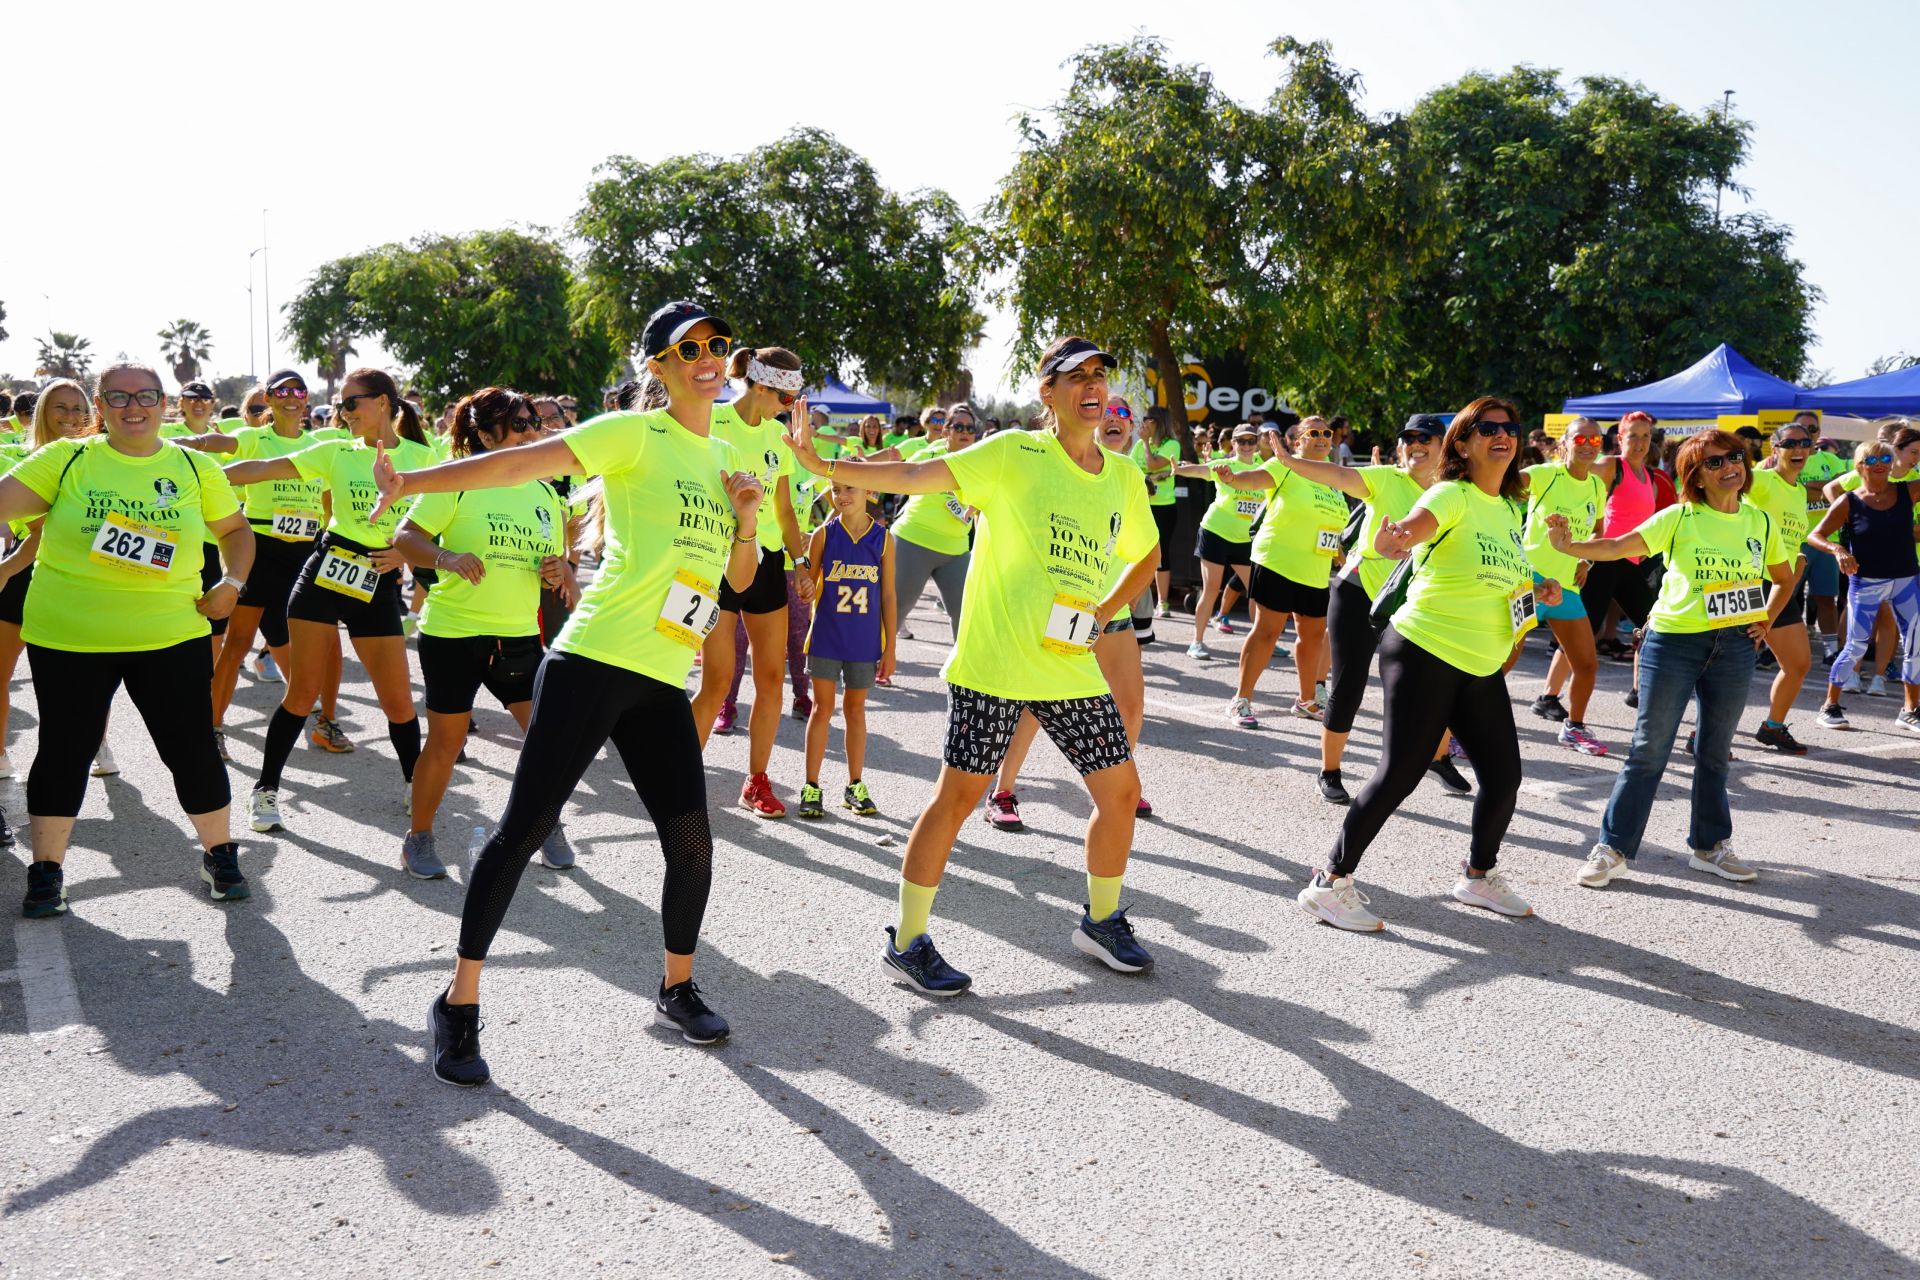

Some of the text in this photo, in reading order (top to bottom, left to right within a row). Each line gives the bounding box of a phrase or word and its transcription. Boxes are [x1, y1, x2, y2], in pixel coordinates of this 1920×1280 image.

[1663, 427, 1684, 436] ONA
[89, 498, 144, 511] YO NO
[350, 489, 369, 499] YO
[680, 493, 724, 517] YO NO
[277, 516, 302, 535] 422
[488, 522, 532, 537] YO NO
[101, 526, 146, 561] 262
[489, 535, 555, 554] RENUNCIO
[1050, 526, 1098, 552] YO NO
[1478, 541, 1514, 560] YO NO
[326, 558, 360, 585] 570
[825, 560, 879, 583] LAKERS
[1695, 557, 1742, 569] YO NO
[682, 594, 702, 627] 2
[836, 585, 868, 614] 24
[1707, 590, 1748, 616] 4758
[1069, 612, 1080, 640] 1
